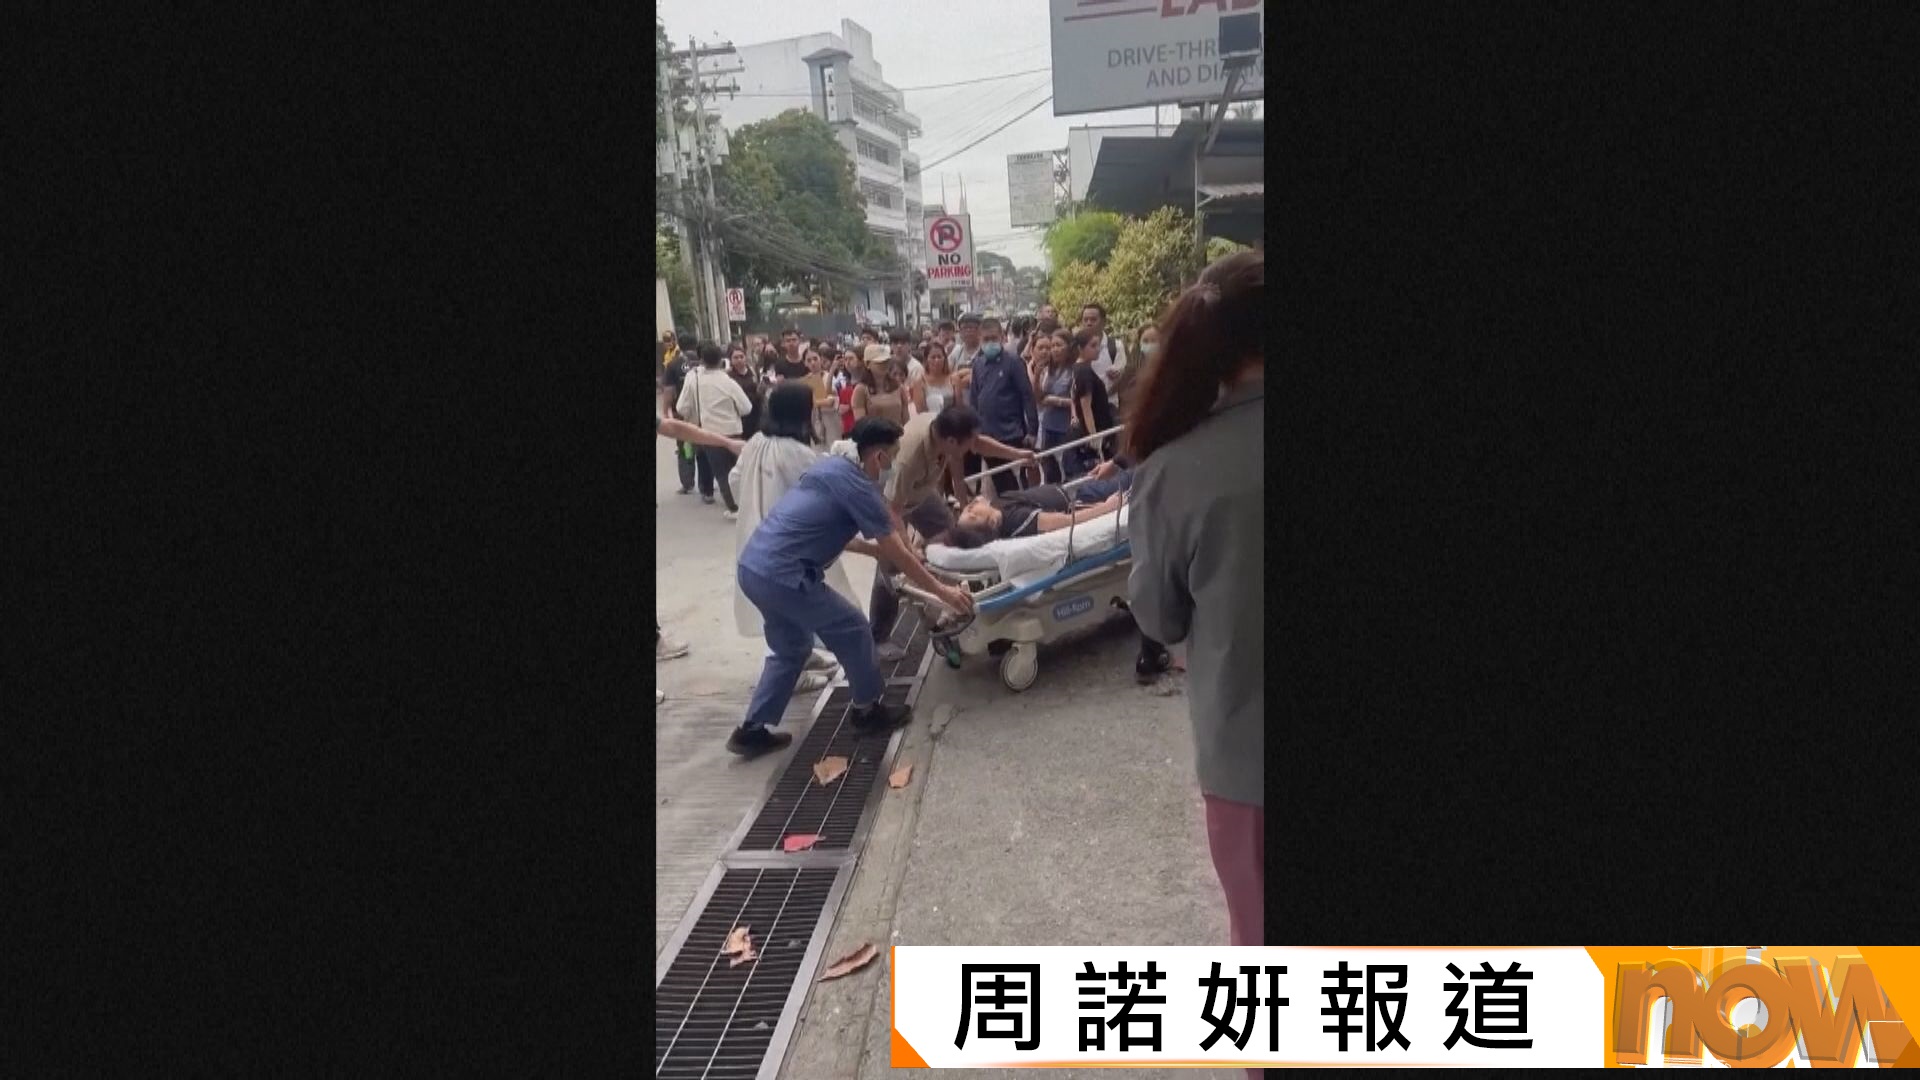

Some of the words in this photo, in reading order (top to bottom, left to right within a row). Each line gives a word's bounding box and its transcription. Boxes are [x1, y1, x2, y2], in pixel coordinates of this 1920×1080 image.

[1107, 37, 1217, 69] DRIVE-THR
[1146, 68, 1191, 89] AND
[938, 252, 961, 266] NO
[928, 264, 971, 279] PARKING
